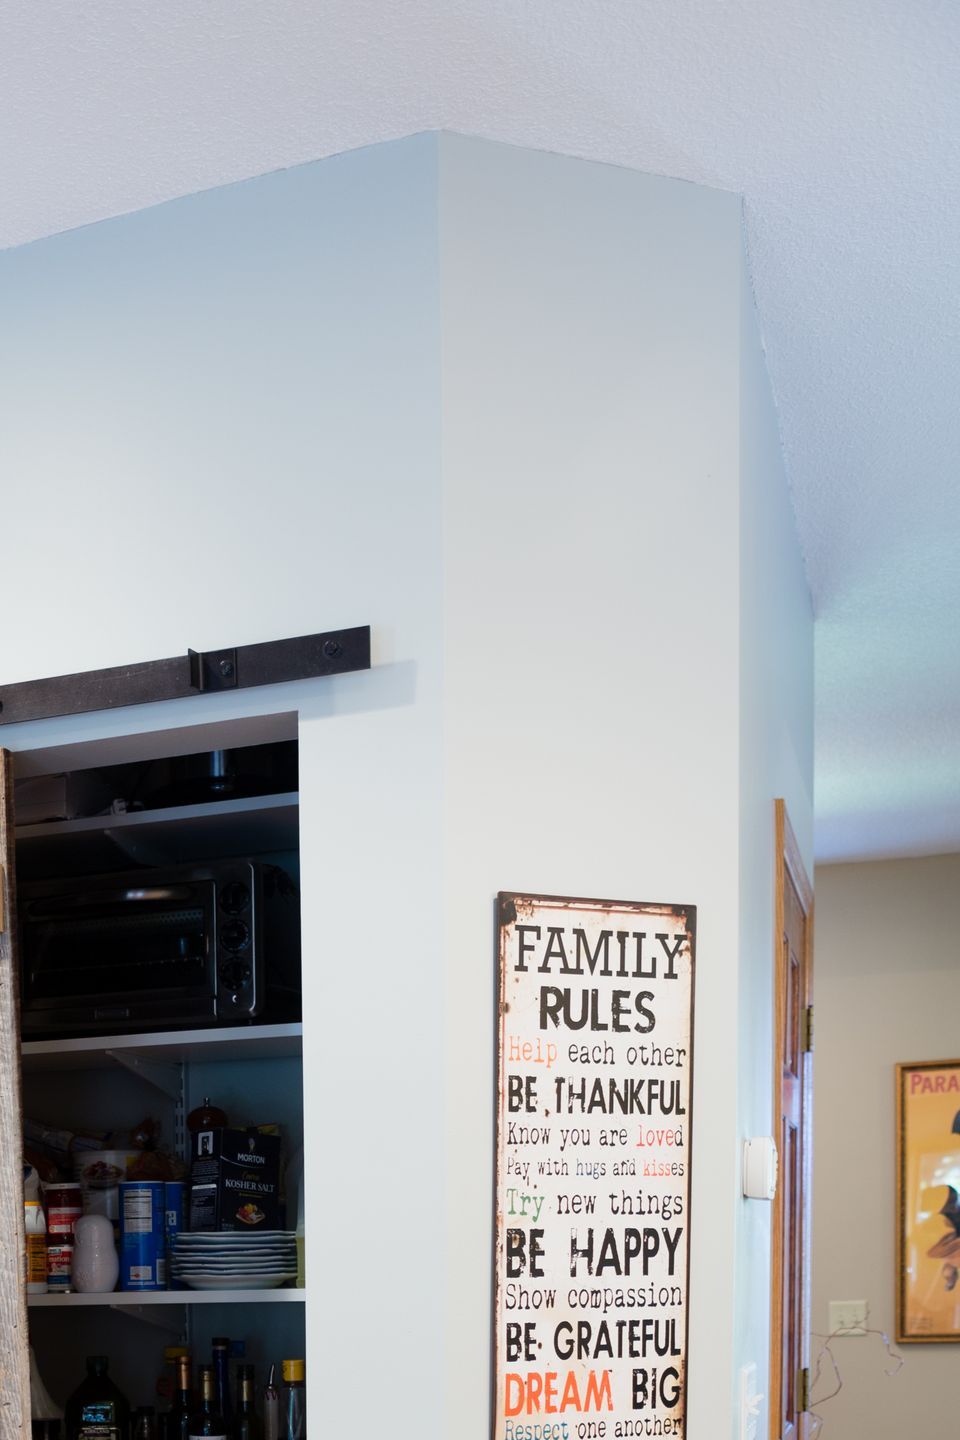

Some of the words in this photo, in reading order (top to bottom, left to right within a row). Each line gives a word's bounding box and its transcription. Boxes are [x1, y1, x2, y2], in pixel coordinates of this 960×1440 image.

[514, 924, 688, 980] FAMILY
[540, 985, 656, 1033] RULES
[508, 1036, 558, 1068] Help
[568, 1040, 616, 1065] each
[626, 1042, 687, 1067] other
[508, 1075, 538, 1113] BE
[555, 1076, 686, 1116] THANKFUL
[507, 1122, 551, 1145] Know
[560, 1126, 591, 1151] you
[599, 1127, 628, 1147] are
[636, 1124, 684, 1147] loved
[237, 1153, 265, 1164] MORTON
[507, 1157, 530, 1181] Pay
[538, 1158, 569, 1177] with
[576, 1158, 607, 1180] hugs
[612, 1158, 636, 1177] and
[643, 1158, 685, 1177] kisses
[225, 1179, 257, 1191] KOSHER
[257, 1183, 276, 1193] SALT
[506, 1189, 545, 1223] Try
[556, 1194, 596, 1215] new
[610, 1190, 683, 1221] things
[506, 1228, 545, 1278] BE
[570, 1227, 684, 1277] HAPPY
[505, 1283, 557, 1310] Show
[567, 1282, 683, 1313] compassion
[506, 1322, 537, 1362] BE
[553, 1319, 681, 1360] GRATEFUL
[504, 1369, 614, 1417] DREAM
[632, 1366, 681, 1410] BIG
[577, 1420, 607, 1439] one
[615, 1415, 682, 1438] another
